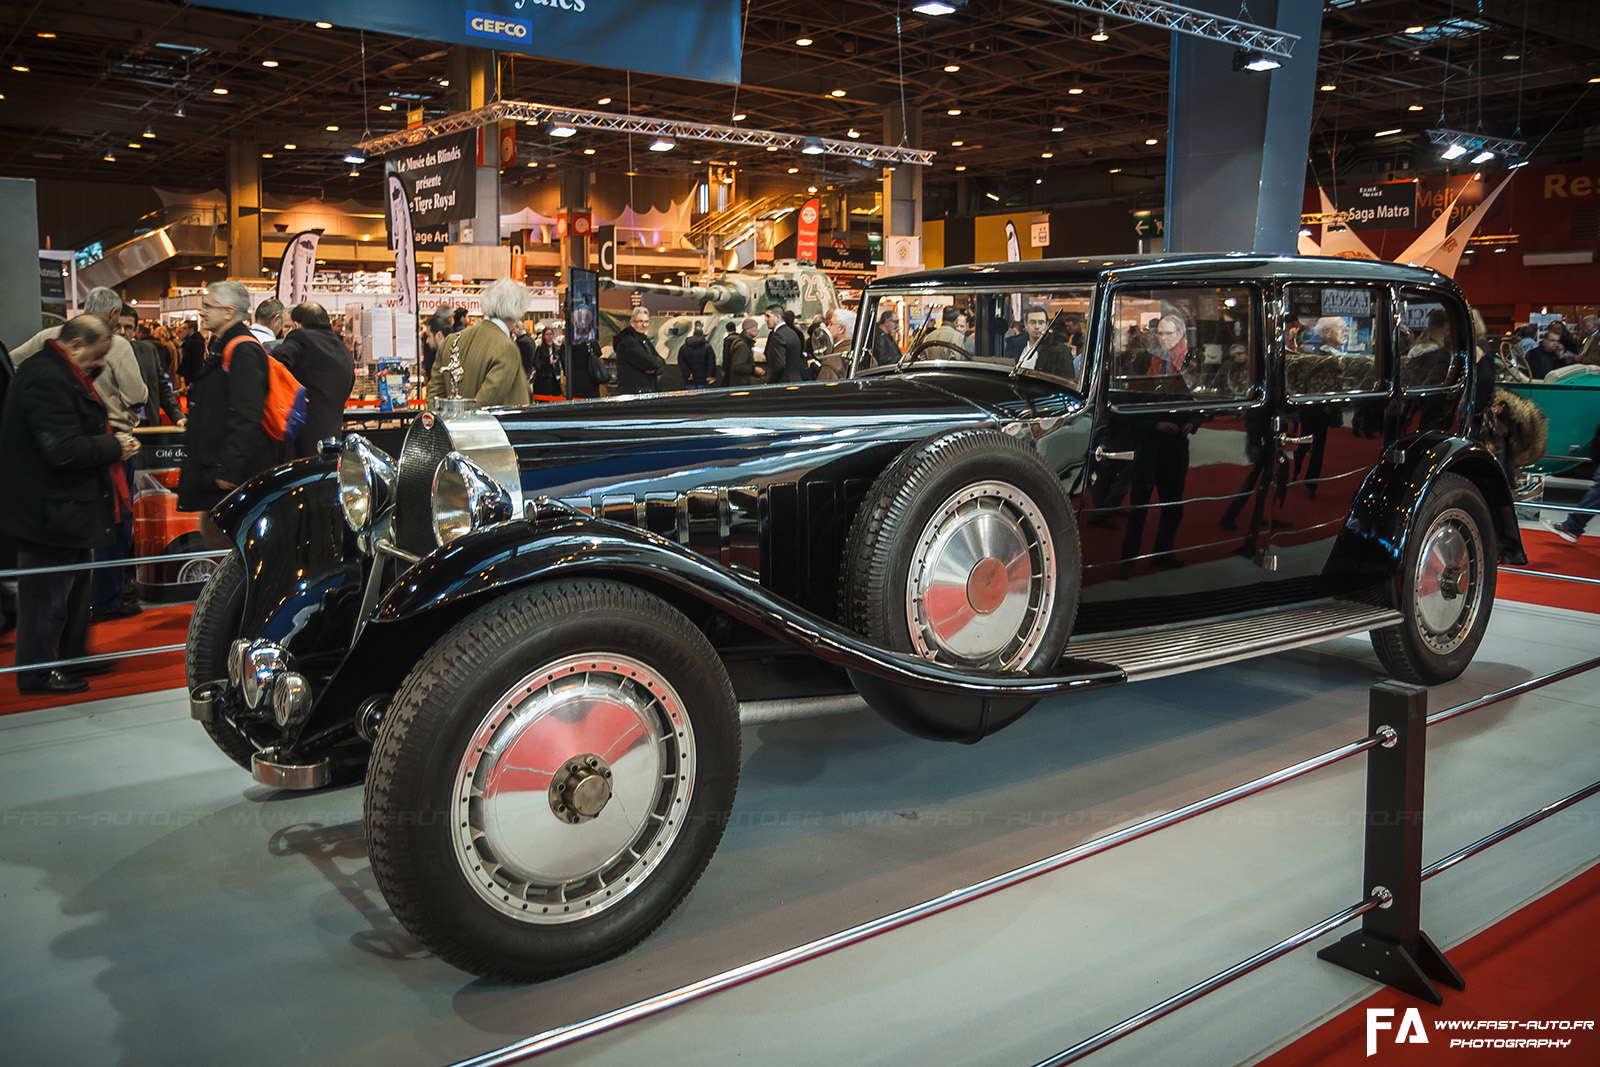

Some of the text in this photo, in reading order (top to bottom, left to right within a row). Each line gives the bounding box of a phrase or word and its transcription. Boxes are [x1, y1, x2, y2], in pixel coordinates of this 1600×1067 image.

[471, 18, 527, 38] GEFCO
[397, 145, 461, 173] Le Musée des Blindés
[415, 174, 442, 194] présente
[1544, 174, 1600, 199] Re
[414, 196, 432, 215] Tigre
[434, 190, 456, 211] Royal
[1416, 187, 1454, 208] Méli
[1349, 206, 1375, 223] Saga
[1376, 204, 1410, 219] Matra
[413, 229, 433, 245] age
[601, 240, 613, 271] C
[821, 258, 864, 270] Village Artisans
[155, 448, 173, 458] Cité
